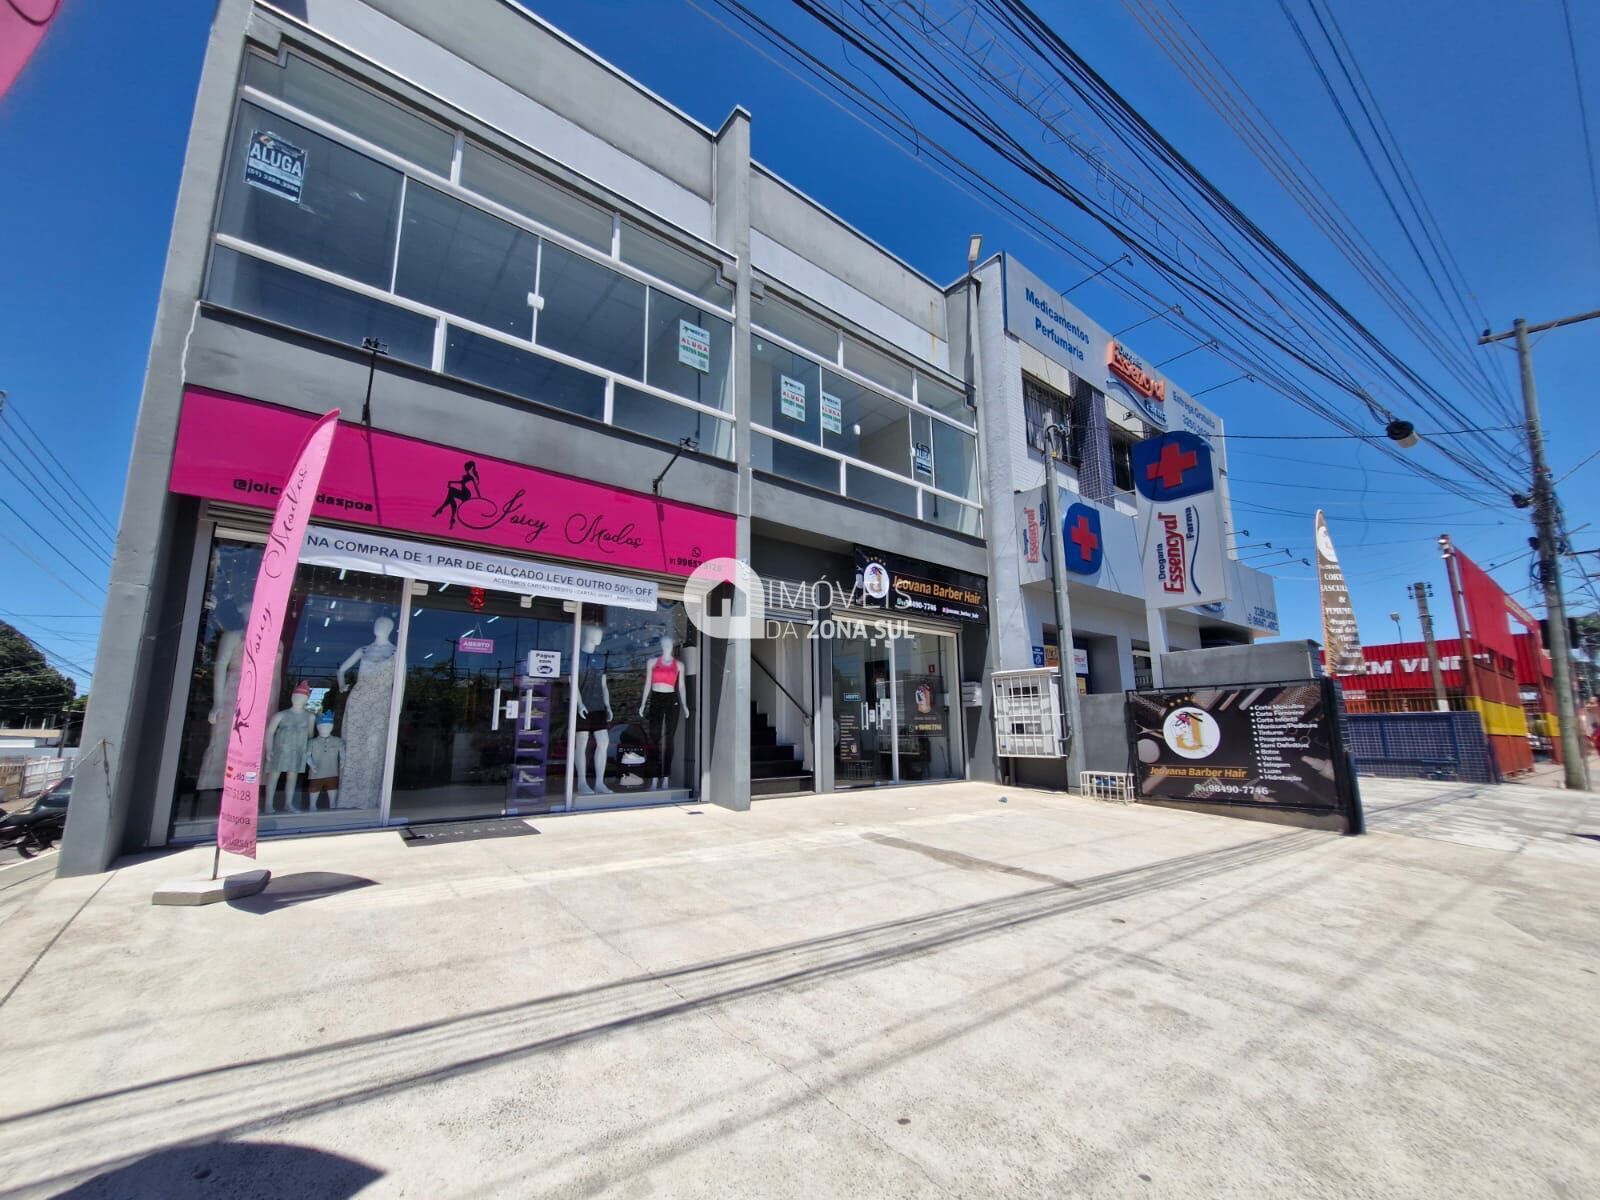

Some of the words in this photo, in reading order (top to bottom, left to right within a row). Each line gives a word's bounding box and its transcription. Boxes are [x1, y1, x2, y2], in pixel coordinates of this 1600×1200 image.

[240, 142, 302, 177] ALUGA
[1025, 287, 1090, 345] Medicamentos
[1035, 317, 1084, 361] Perfumaria
[233, 478, 373, 513] @joicdaspoa
[1185, 507, 1195, 540] Farma
[307, 535, 329, 548] NA
[334, 539, 399, 559] COMPRA
[404, 550, 422, 562] DE
[427, 554, 432, 564] 1
[437, 556, 462, 569] PAR
[466, 560, 483, 571] DE
[486, 564, 544, 581] CALÇADO
[546, 575, 573, 586] LEVE
[576, 578, 612, 591] OUTRO
[635, 587, 653, 597] OFF
[1157, 543, 1167, 580] Drogaria
[1158, 512, 1185, 592] Essencyal
[893, 575, 932, 594] Jeovana
[933, 585, 963, 601] Barber
[964, 590, 981, 605] Hair
[1150, 766, 1187, 776] Jeovana
[1188, 767, 1222, 777] Barber
[1224, 768, 1248, 778] Hair
